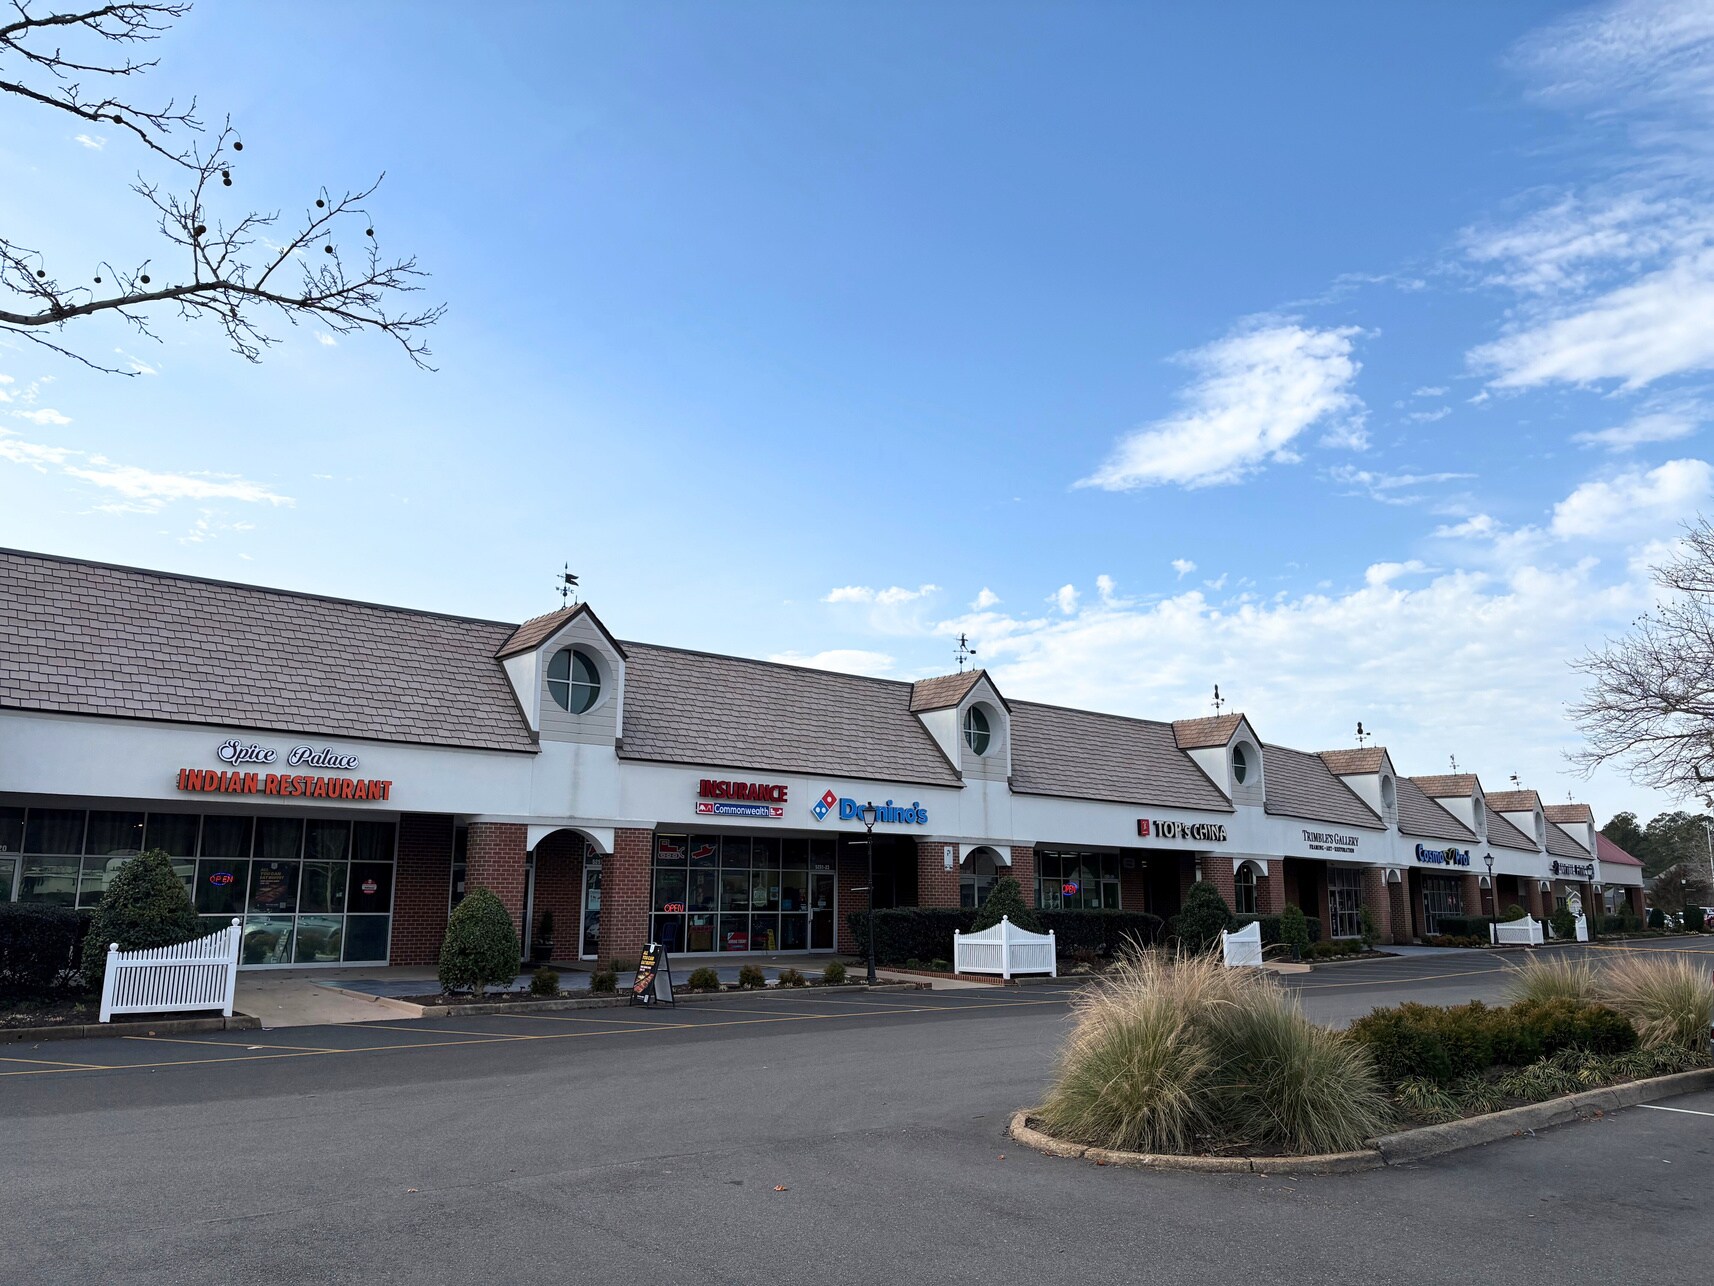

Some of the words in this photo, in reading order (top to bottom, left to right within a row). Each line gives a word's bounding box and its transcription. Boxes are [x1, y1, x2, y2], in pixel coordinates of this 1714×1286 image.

[217, 738, 278, 766] Spice
[287, 744, 360, 769] Palace
[178, 768, 259, 794] INDIAN
[264, 773, 393, 800] RESTAURANT
[699, 779, 788, 802] INSURANCE
[714, 803, 769, 816] Commonwealth
[1154, 820, 1190, 839] TOP's
[1191, 823, 1227, 841] CHINA
[1333, 833, 1359, 846] GALLERY
[209, 875, 234, 883] OPEN
[1062, 884, 1077, 894] OPEN
[664, 903, 684, 912] OPEN
